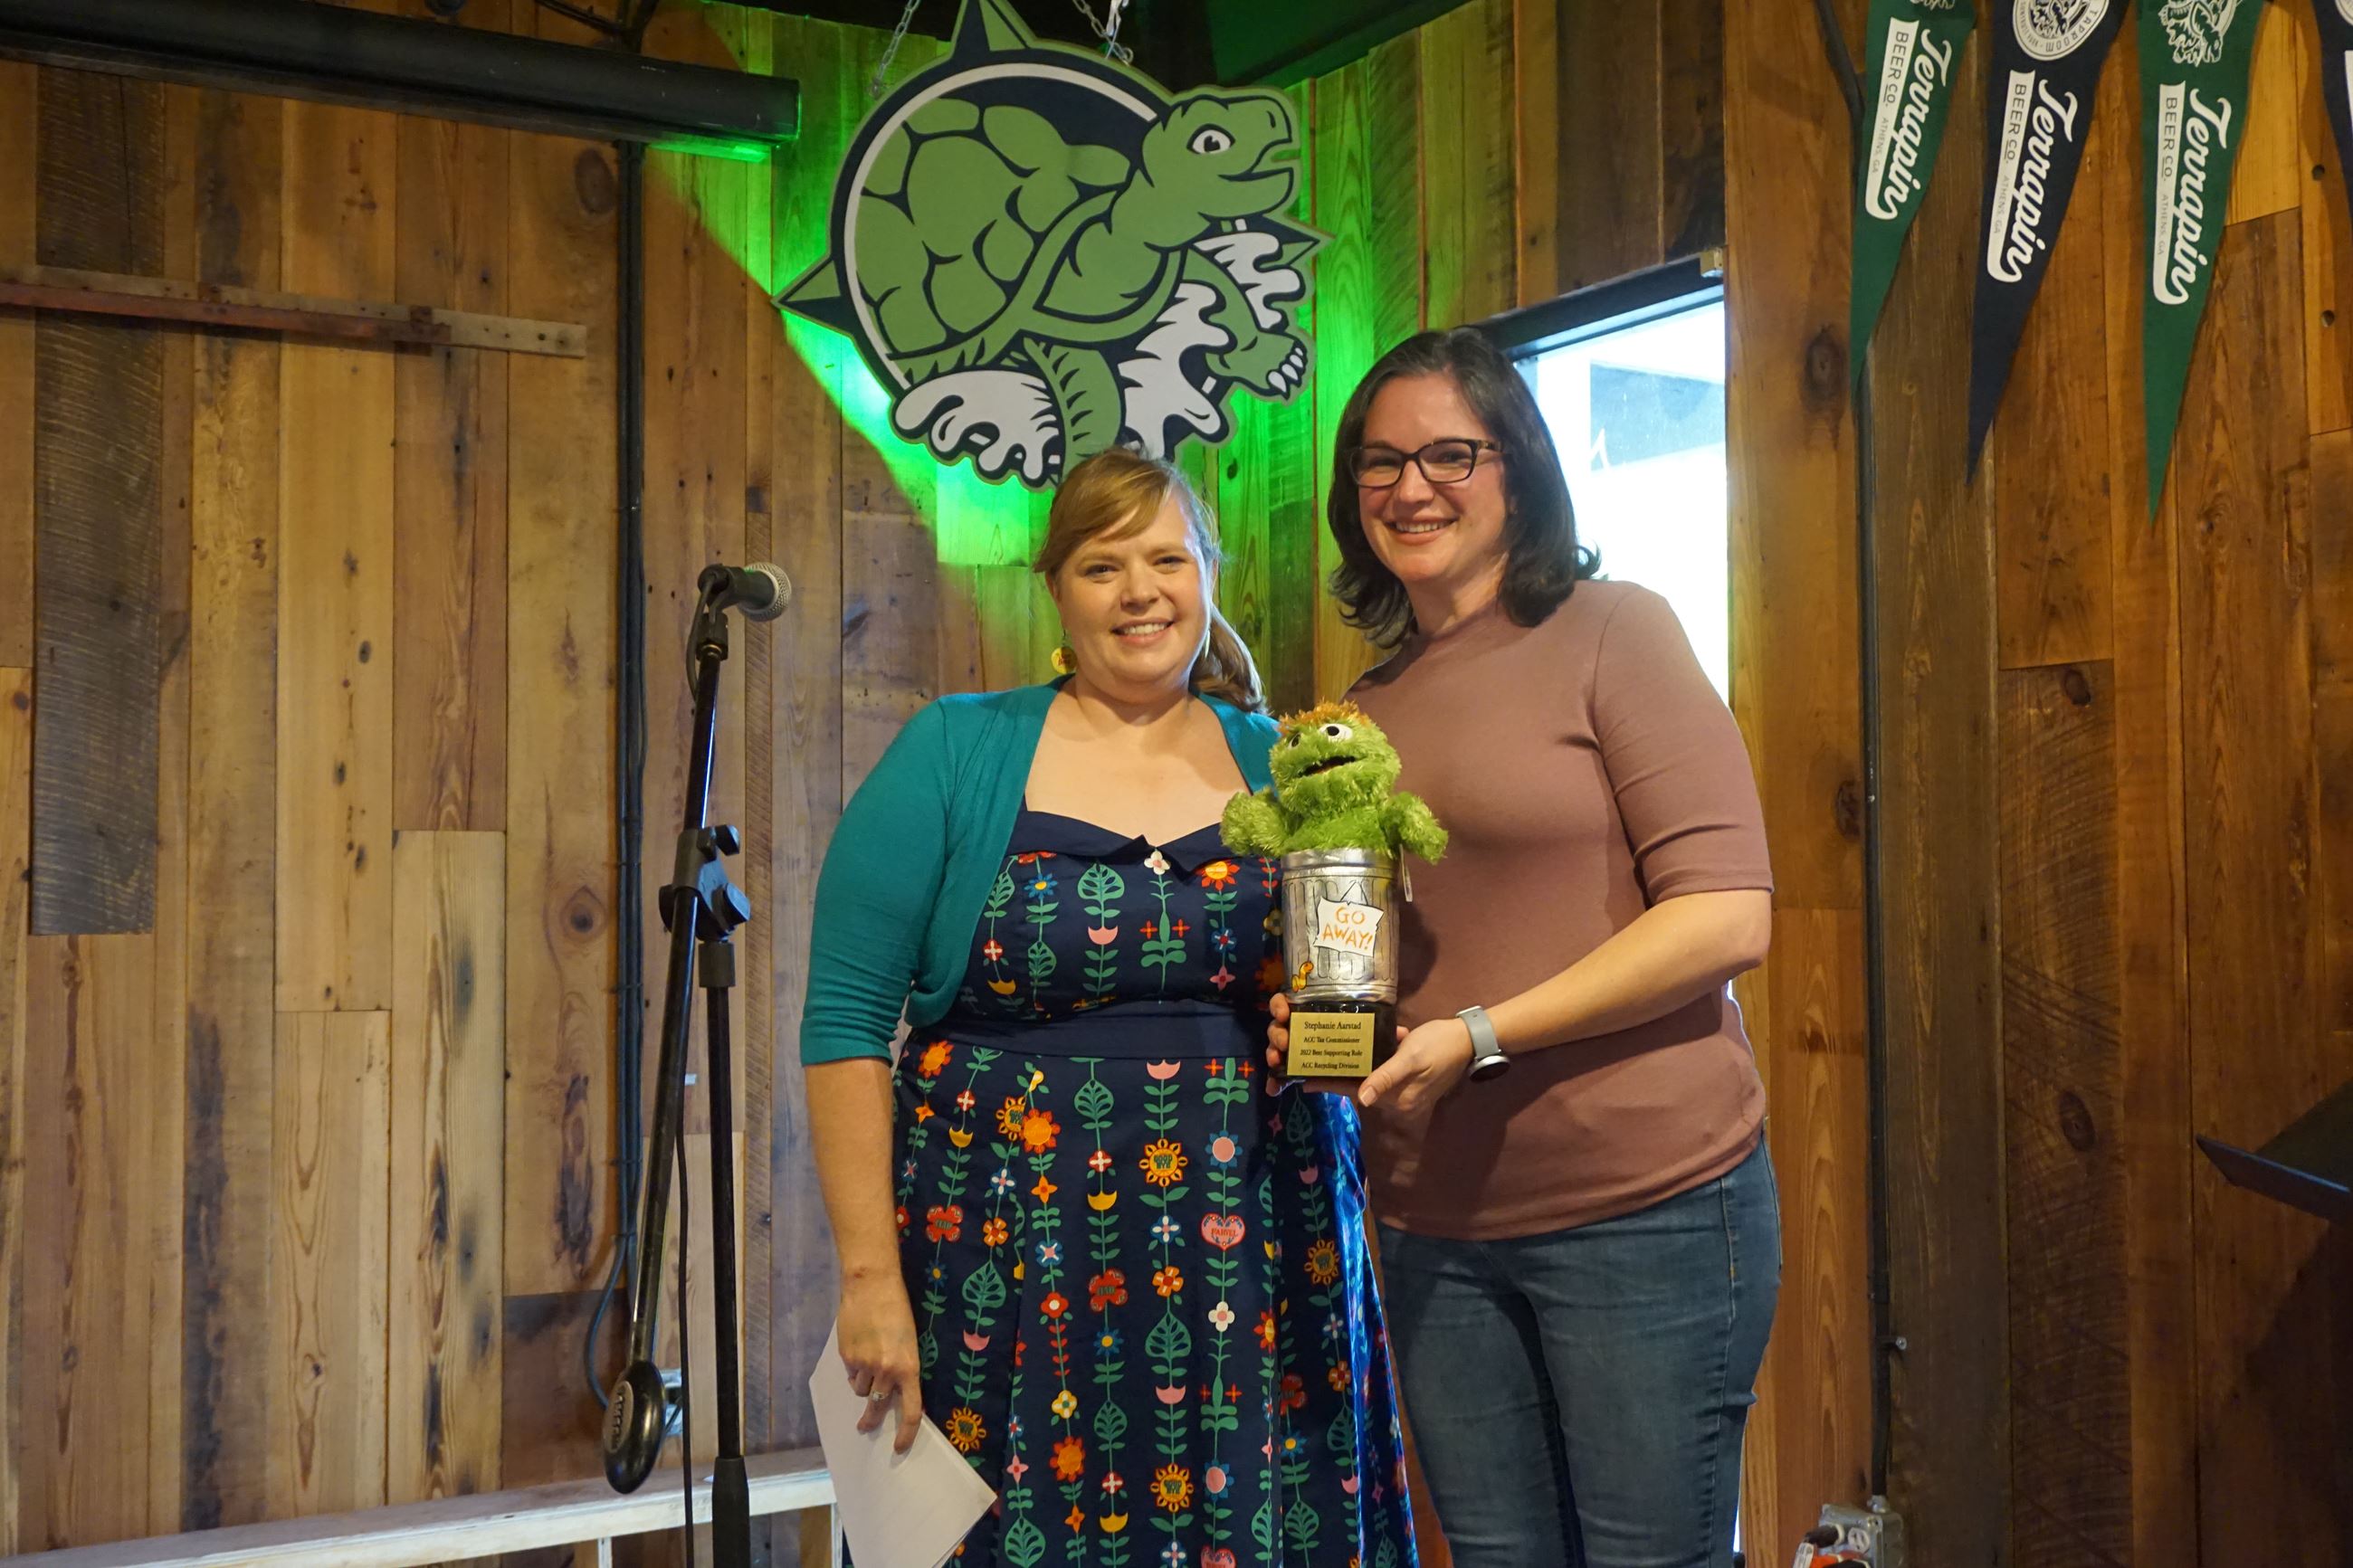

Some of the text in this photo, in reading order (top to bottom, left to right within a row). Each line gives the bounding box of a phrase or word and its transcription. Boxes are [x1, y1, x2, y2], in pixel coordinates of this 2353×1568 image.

[1887, 31, 1909, 80] BEER
[1883, 29, 1952, 219] Terrapin
[2008, 83, 2026, 136] BEER
[2163, 97, 2177, 151] BEER
[2006, 79, 2078, 282] Terrapin
[2170, 88, 2232, 304] Terrapin
[1321, 923, 1373, 950] AWAY!
[1335, 907, 1366, 924] GO
[1304, 1022, 1361, 1031] Stephanie Aarstad
